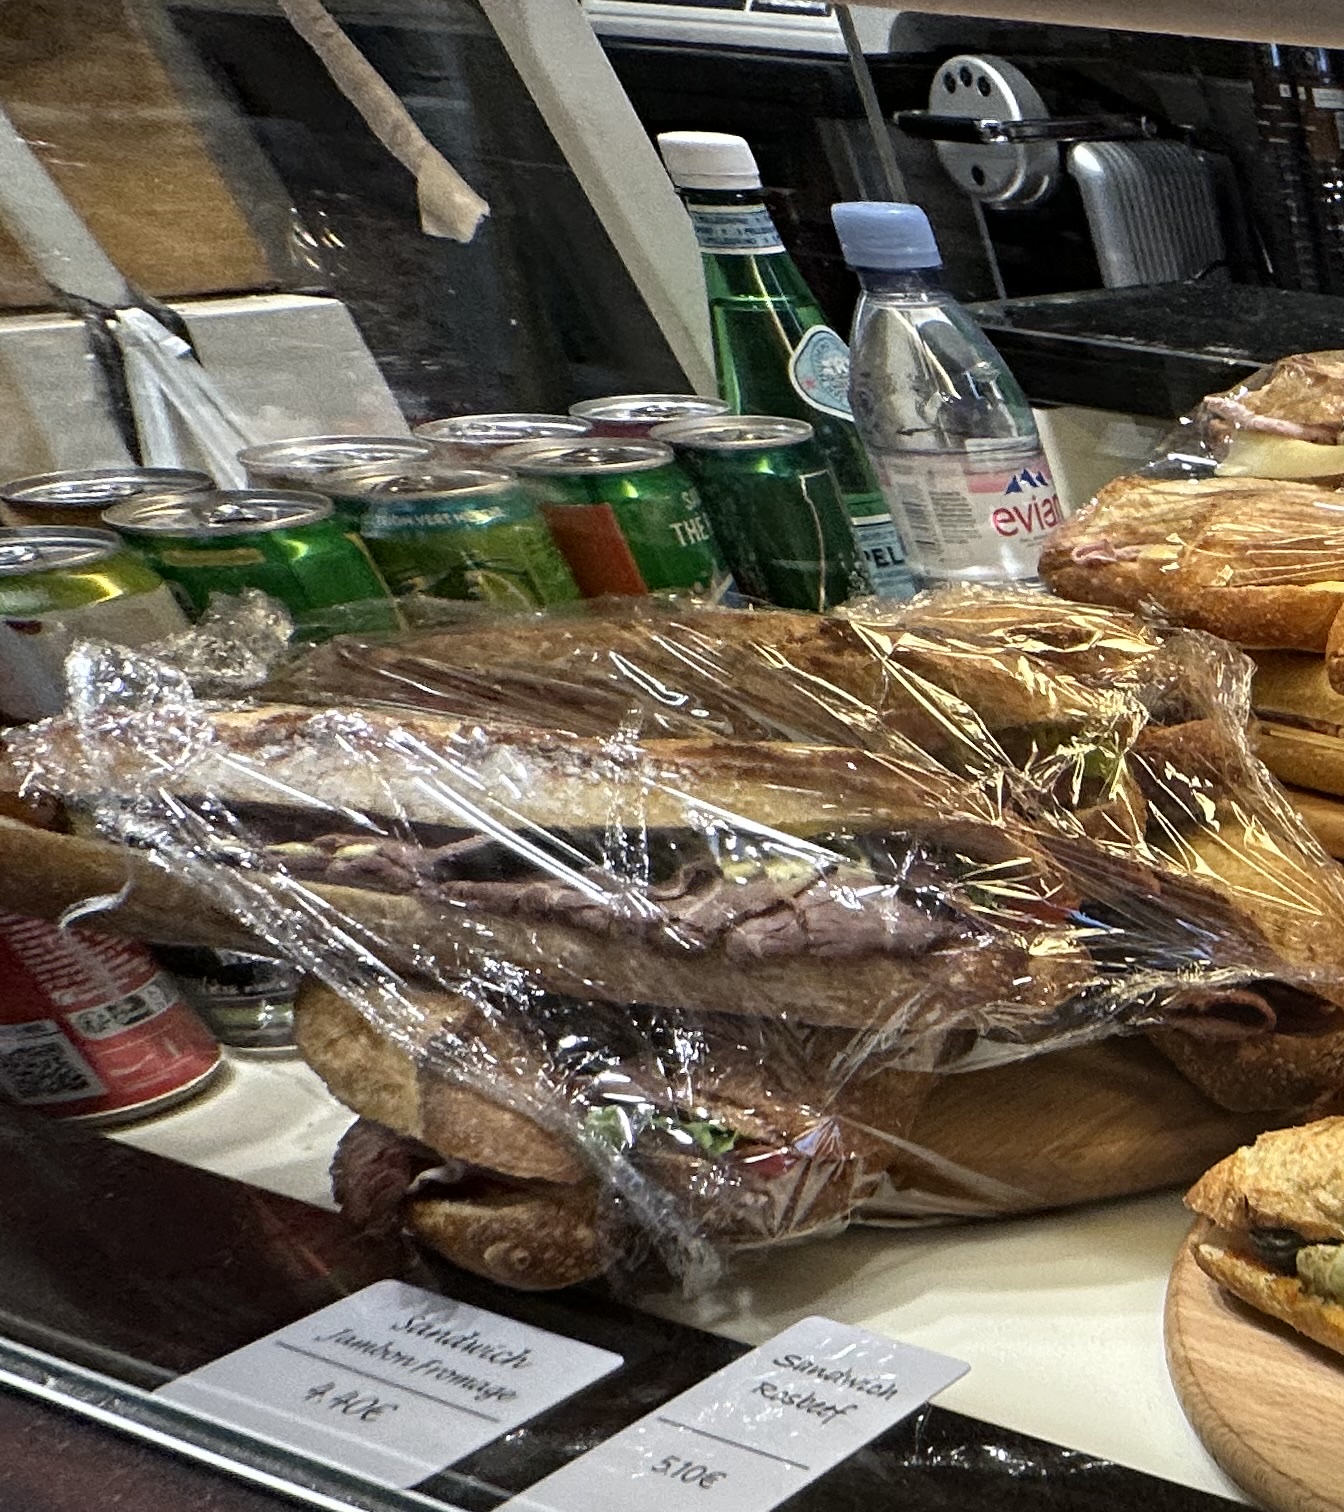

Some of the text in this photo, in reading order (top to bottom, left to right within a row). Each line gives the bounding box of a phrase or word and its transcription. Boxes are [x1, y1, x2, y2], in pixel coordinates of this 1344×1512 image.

[992, 494, 1064, 536] evian
[312, 1328, 415, 1367] Jambon
[390, 1315, 532, 1369] Sandwich
[773, 1353, 898, 1401] Sandwich
